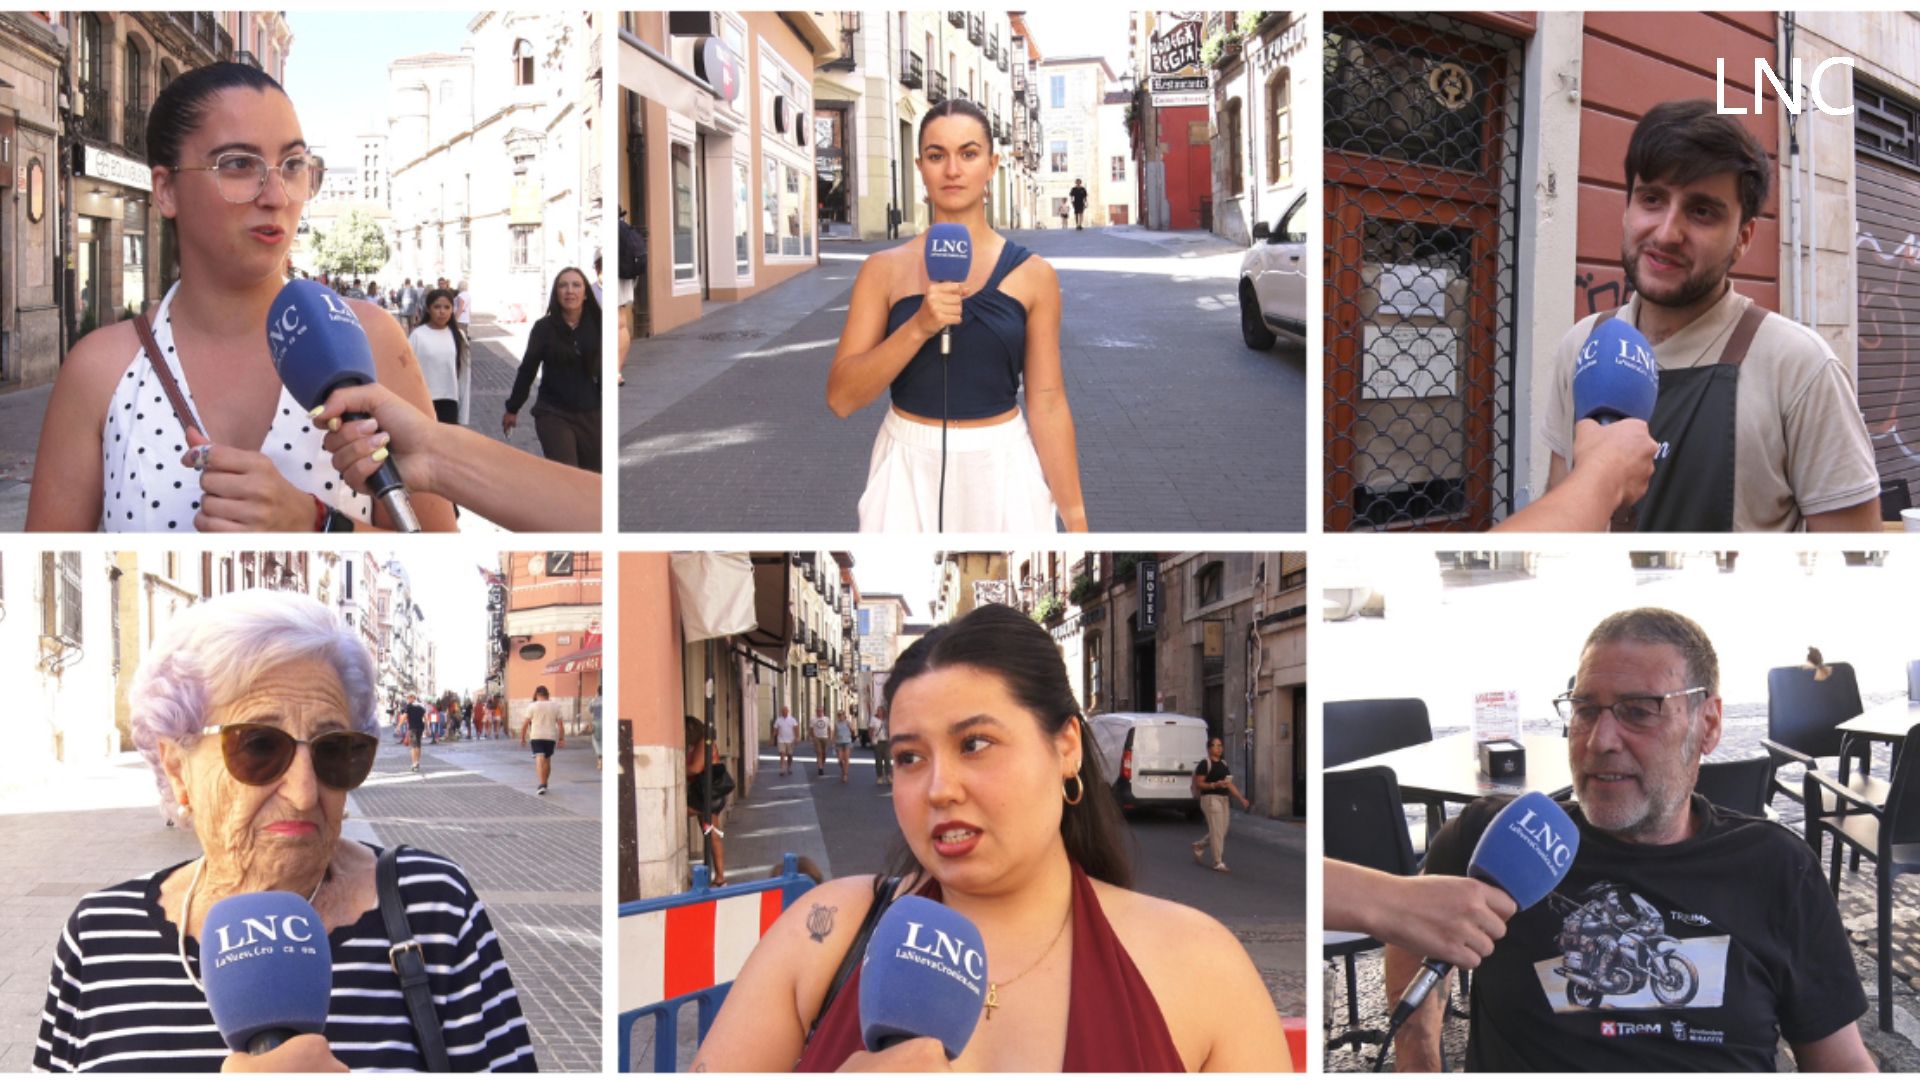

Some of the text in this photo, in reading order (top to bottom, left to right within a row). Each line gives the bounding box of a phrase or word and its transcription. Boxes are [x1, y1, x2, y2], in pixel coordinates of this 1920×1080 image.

[932, 239, 968, 253] LNC
[1146, 570, 1155, 624] HOTEL
[1516, 808, 1570, 867] LNC
[215, 915, 312, 954] LNC
[902, 921, 983, 980] LNC
